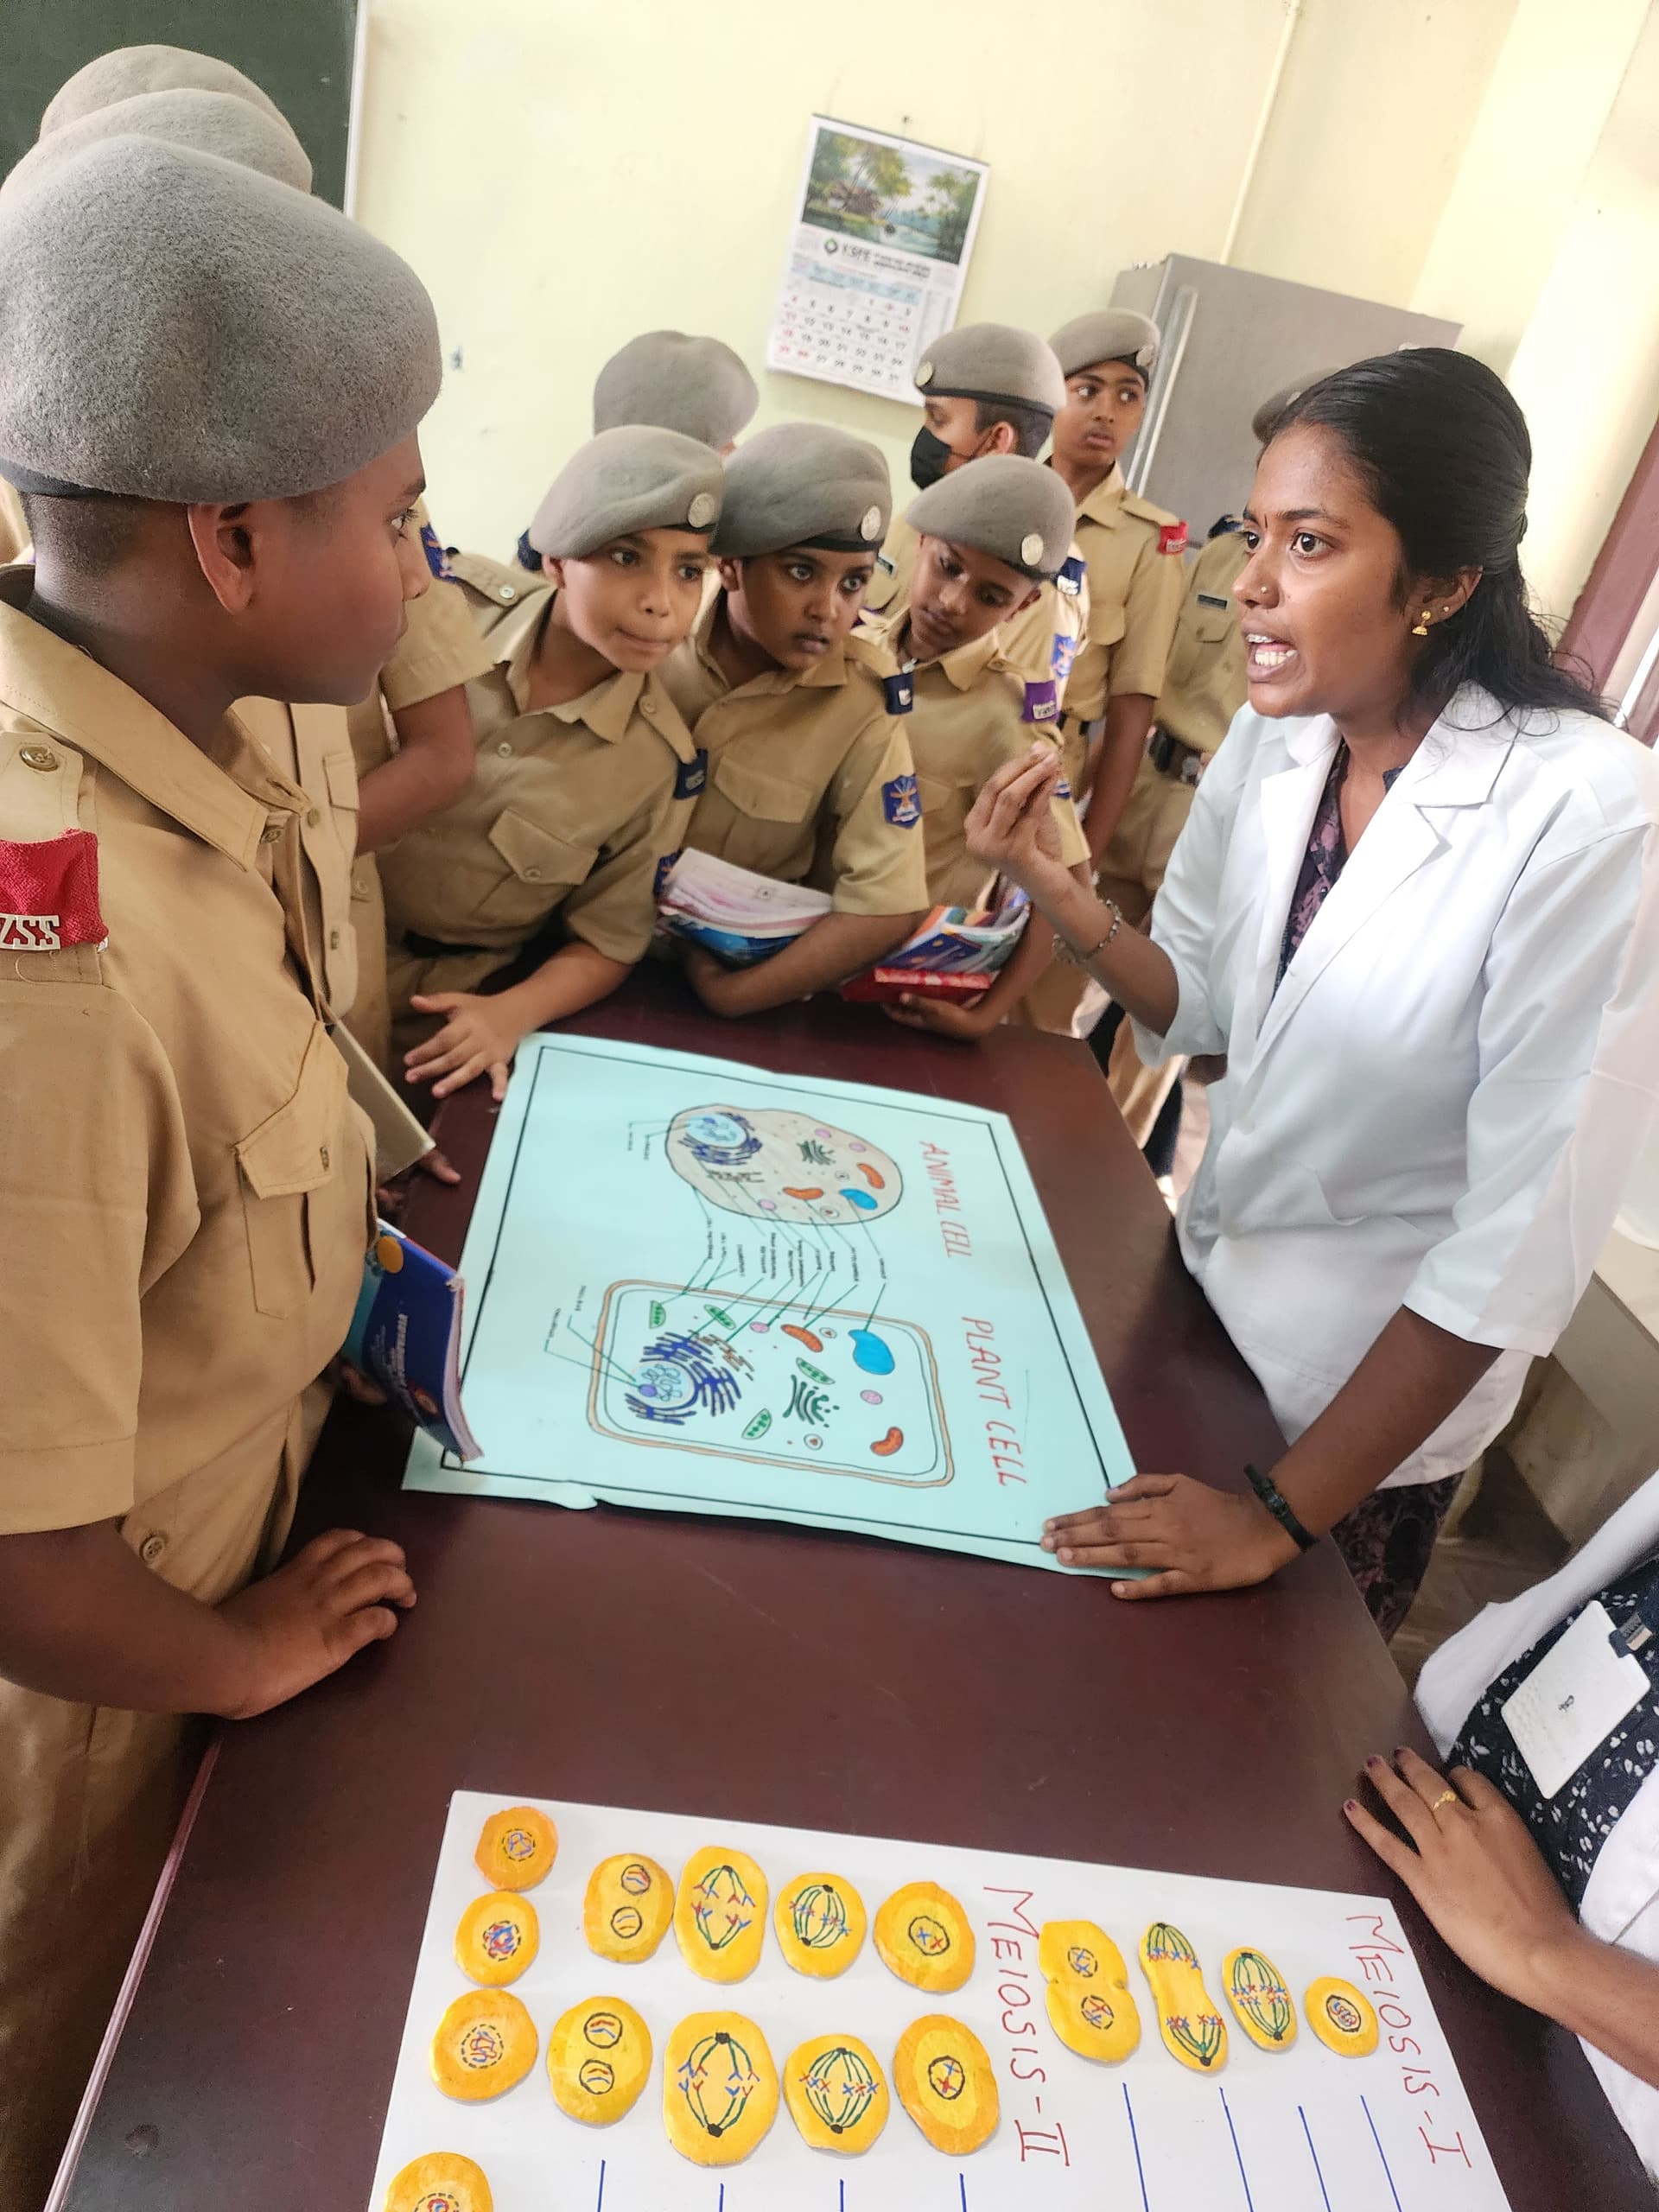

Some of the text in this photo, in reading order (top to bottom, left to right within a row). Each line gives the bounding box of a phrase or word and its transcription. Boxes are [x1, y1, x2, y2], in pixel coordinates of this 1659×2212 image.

[919, 1141, 972, 1258] ANIMAL CELL
[962, 1316, 1027, 1486] PLANT CELL
